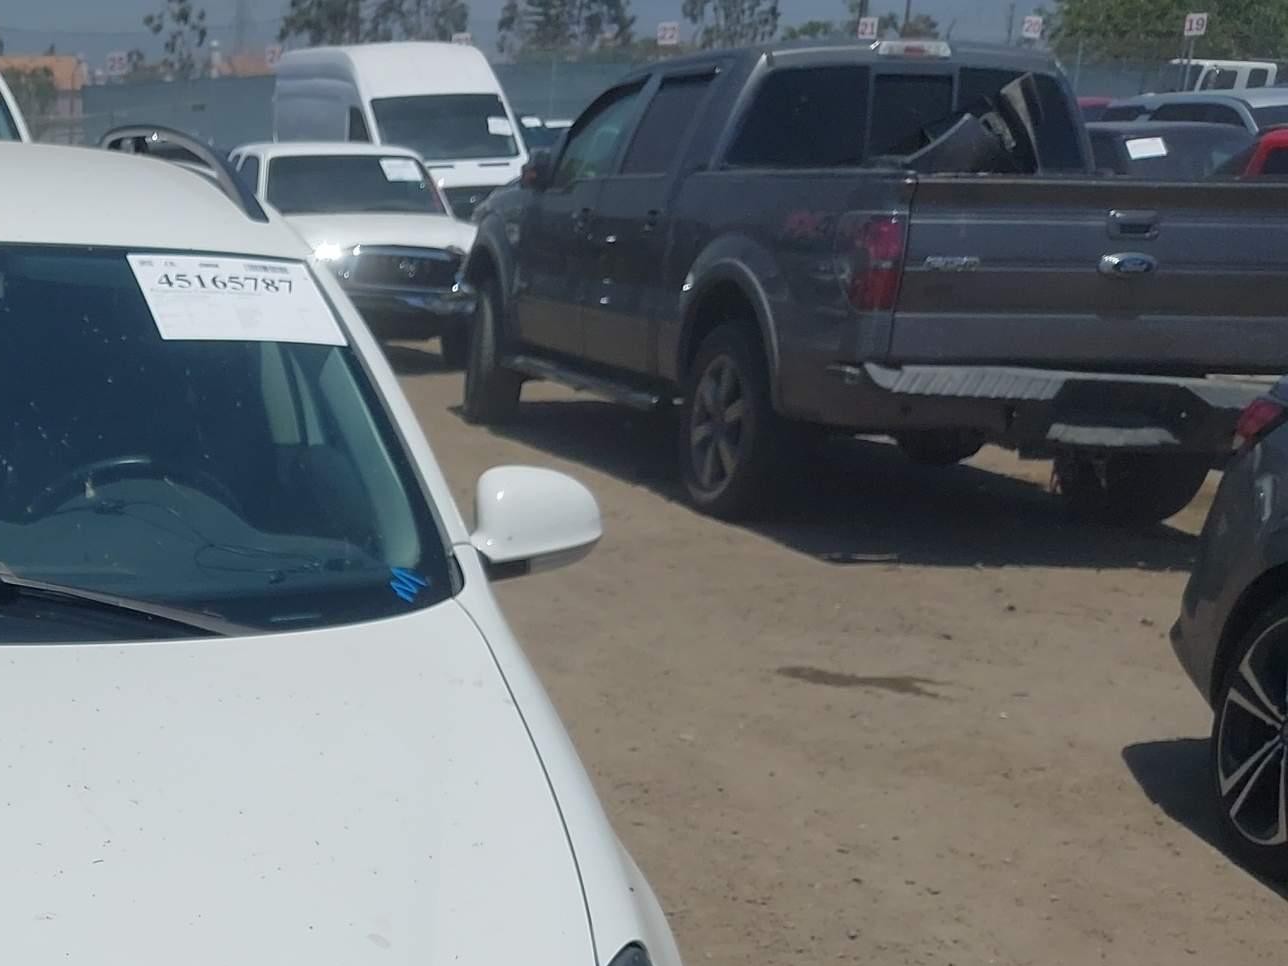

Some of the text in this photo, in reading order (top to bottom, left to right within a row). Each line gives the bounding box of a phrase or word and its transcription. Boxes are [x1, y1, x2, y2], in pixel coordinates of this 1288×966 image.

[861, 22, 874, 35] 21
[1025, 19, 1041, 33] 20
[1187, 17, 1205, 31] 19
[158, 272, 293, 295] 45165787
